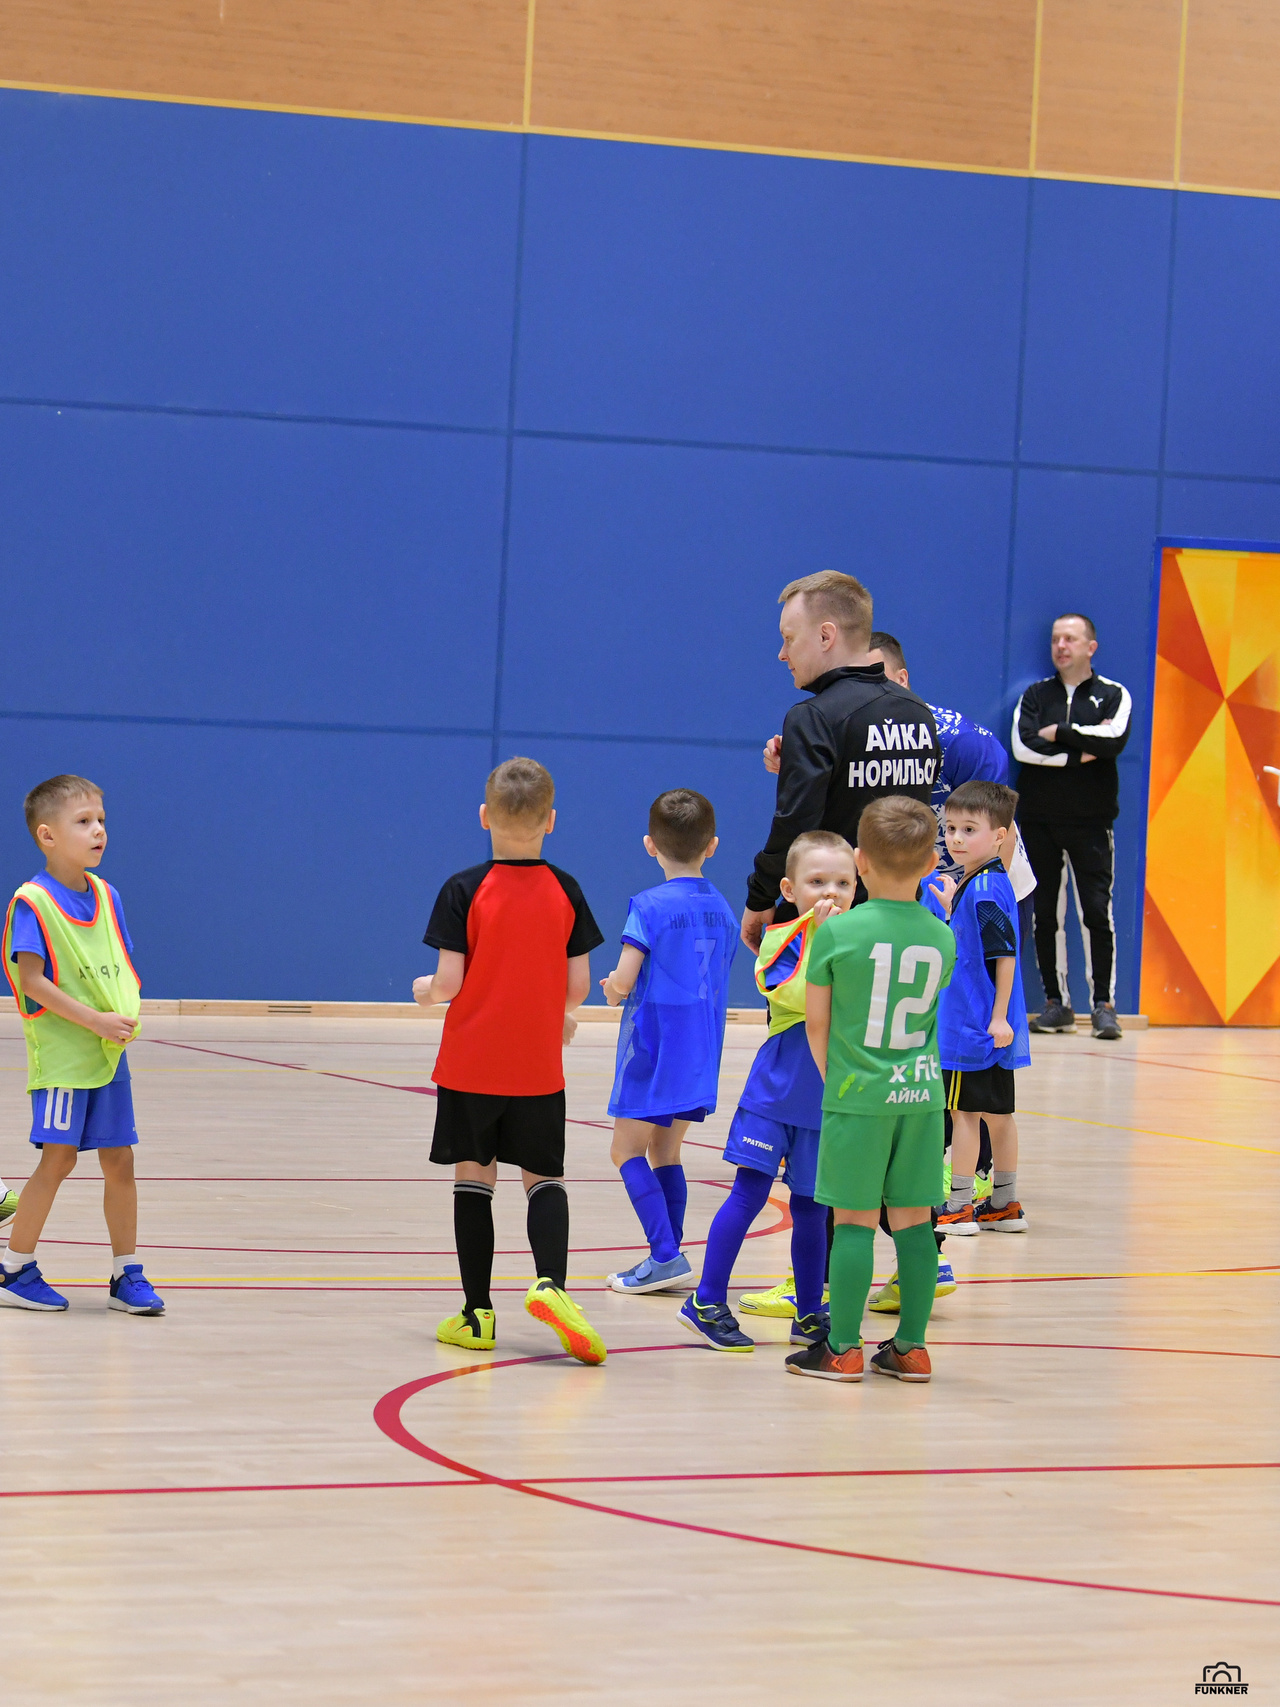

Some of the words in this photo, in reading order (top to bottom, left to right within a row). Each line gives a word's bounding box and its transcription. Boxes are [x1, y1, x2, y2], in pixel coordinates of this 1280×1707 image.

[865, 719, 933, 751] АЙКА
[864, 942, 942, 1050] 12
[43, 1087, 74, 1131] 10
[885, 1087, 930, 1103] АЙКА
[746, 1138, 774, 1151] PATRICK
